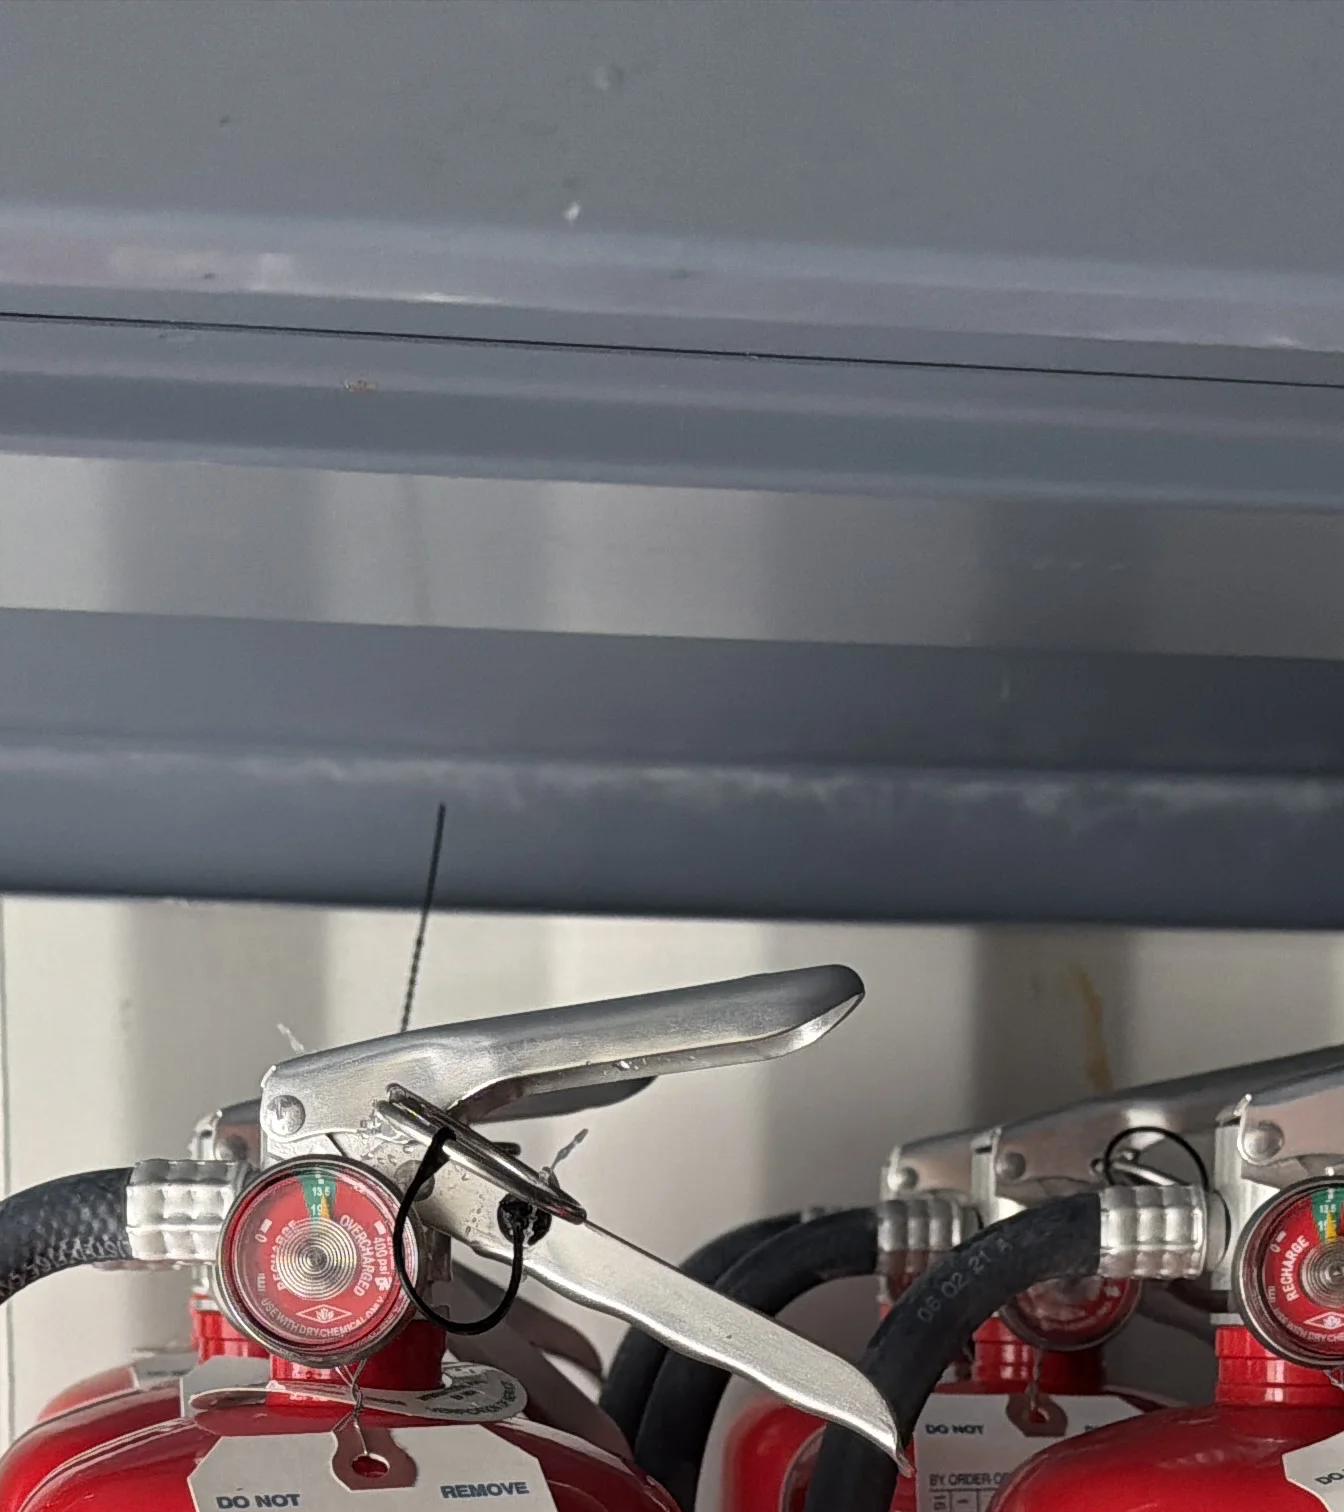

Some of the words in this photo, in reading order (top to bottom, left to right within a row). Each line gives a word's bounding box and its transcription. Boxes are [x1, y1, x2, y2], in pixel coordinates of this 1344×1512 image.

[1314, 1472, 1344, 1485] DO
[439, 1481, 530, 1498] REMOVE
[215, 1495, 250, 1509] DO
[254, 1493, 300, 1508] NOT
